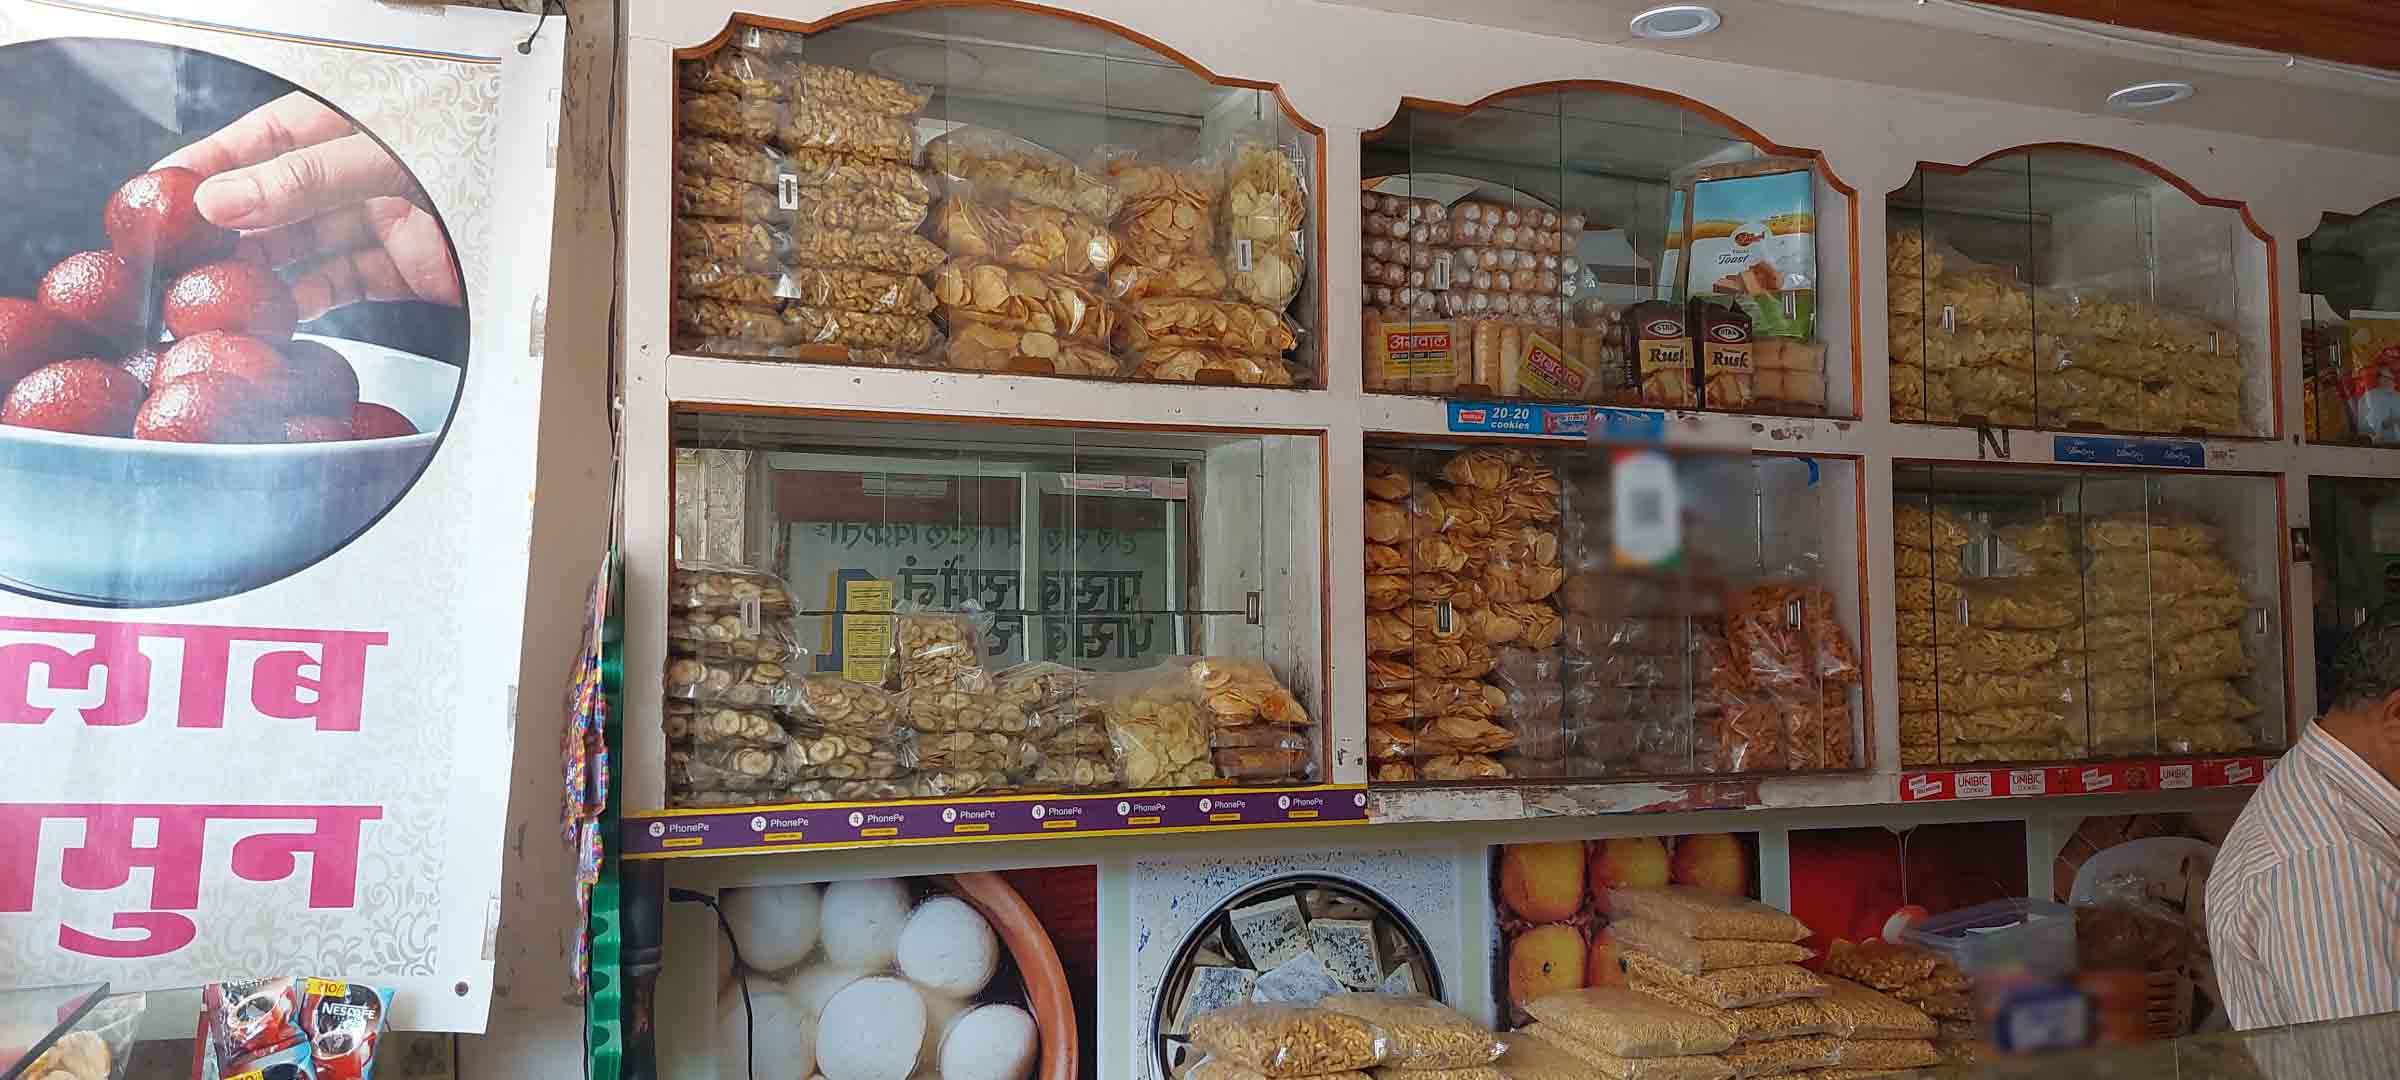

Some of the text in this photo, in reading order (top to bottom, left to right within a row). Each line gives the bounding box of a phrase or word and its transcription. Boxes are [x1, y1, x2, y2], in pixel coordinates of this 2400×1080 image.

[1712, 351, 1750, 368] Rusk
[1491, 408, 1529, 420] 20-20
[1491, 421, 1529, 430] cookies
[1958, 776, 1988, 787] UNIBIC
[2013, 774, 2041, 785] UNIBIC
[669, 797, 1324, 833] PhonePe PhonePe PhonePe PhonePe PhonePe PhonePe PhonePe PhonePe
